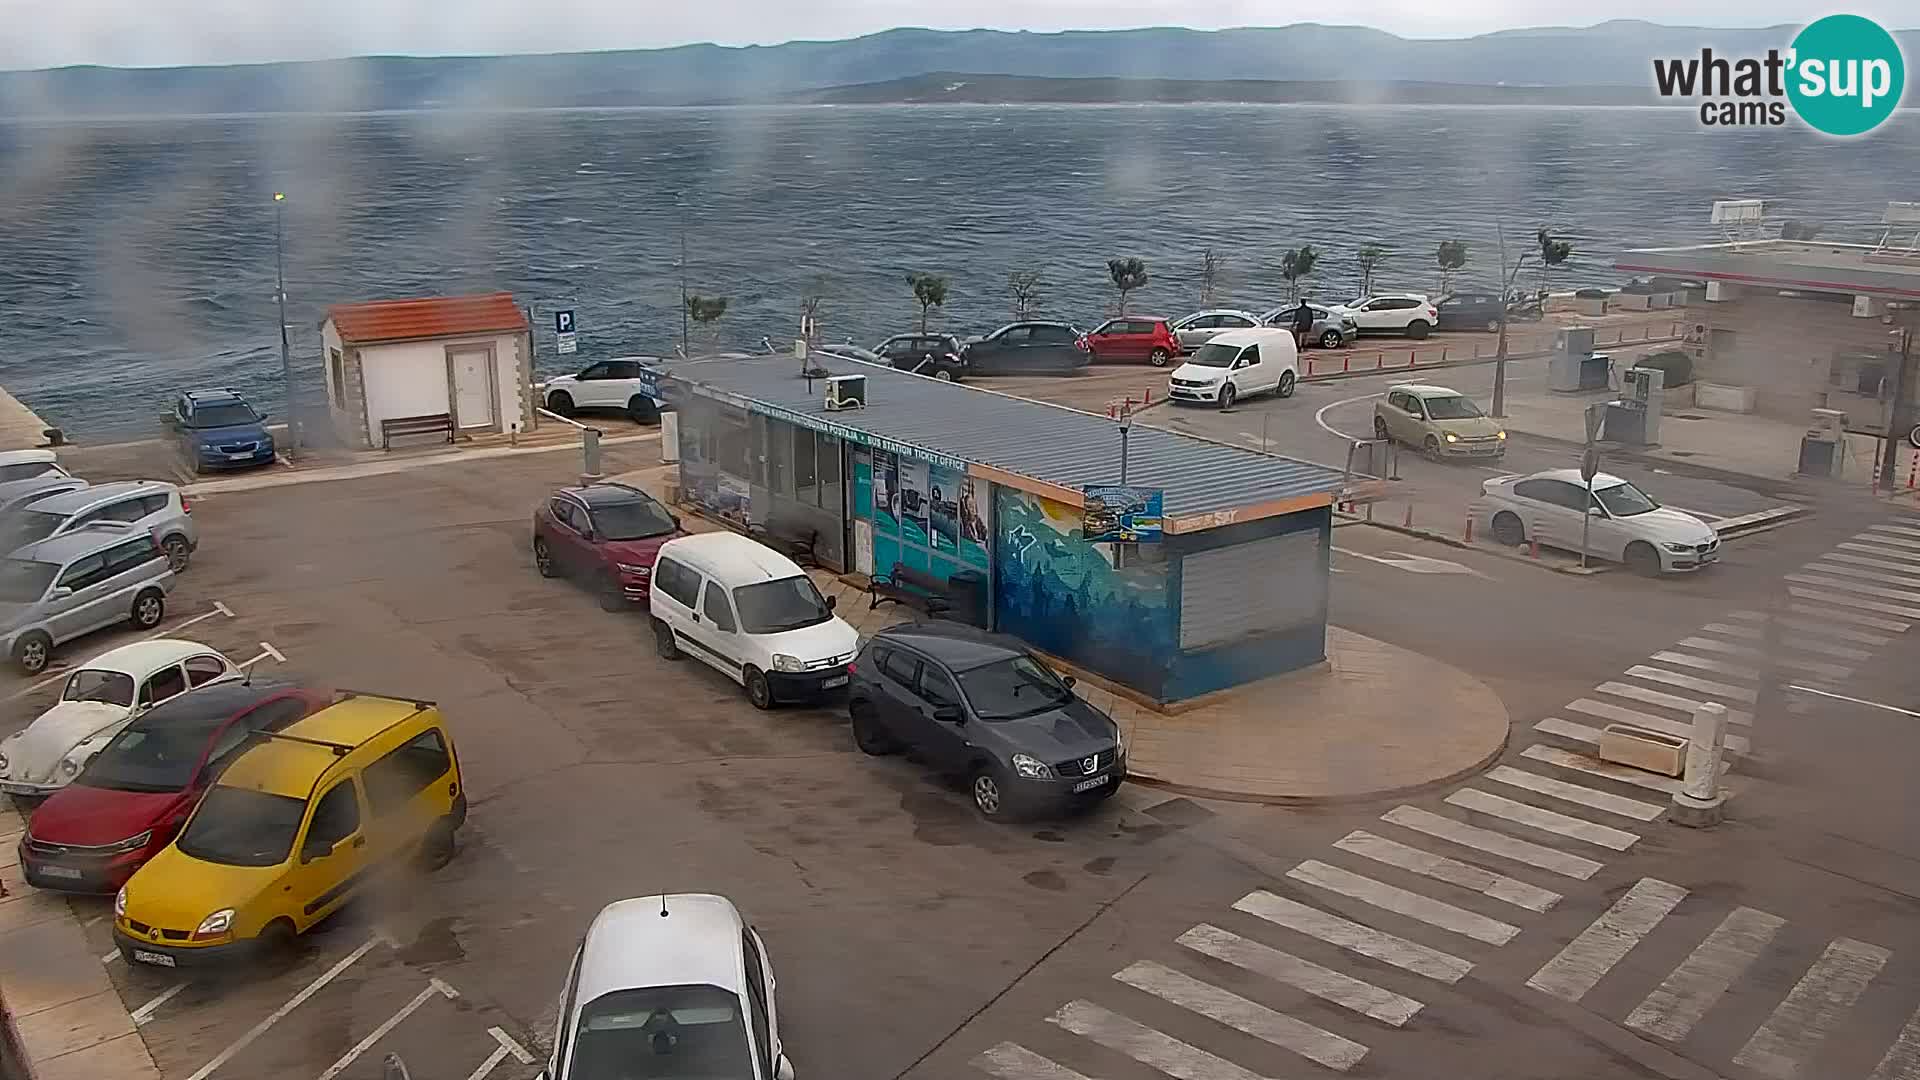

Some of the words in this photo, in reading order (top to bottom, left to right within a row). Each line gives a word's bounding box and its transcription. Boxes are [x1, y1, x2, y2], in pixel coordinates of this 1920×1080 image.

[560, 313, 570, 330] P
[829, 424, 858, 441] POSTAJA
[867, 435, 881, 448] BUS
[882, 440, 912, 456] STATION
[914, 448, 938, 463] TICKET
[940, 457, 965, 472] OFFICE
